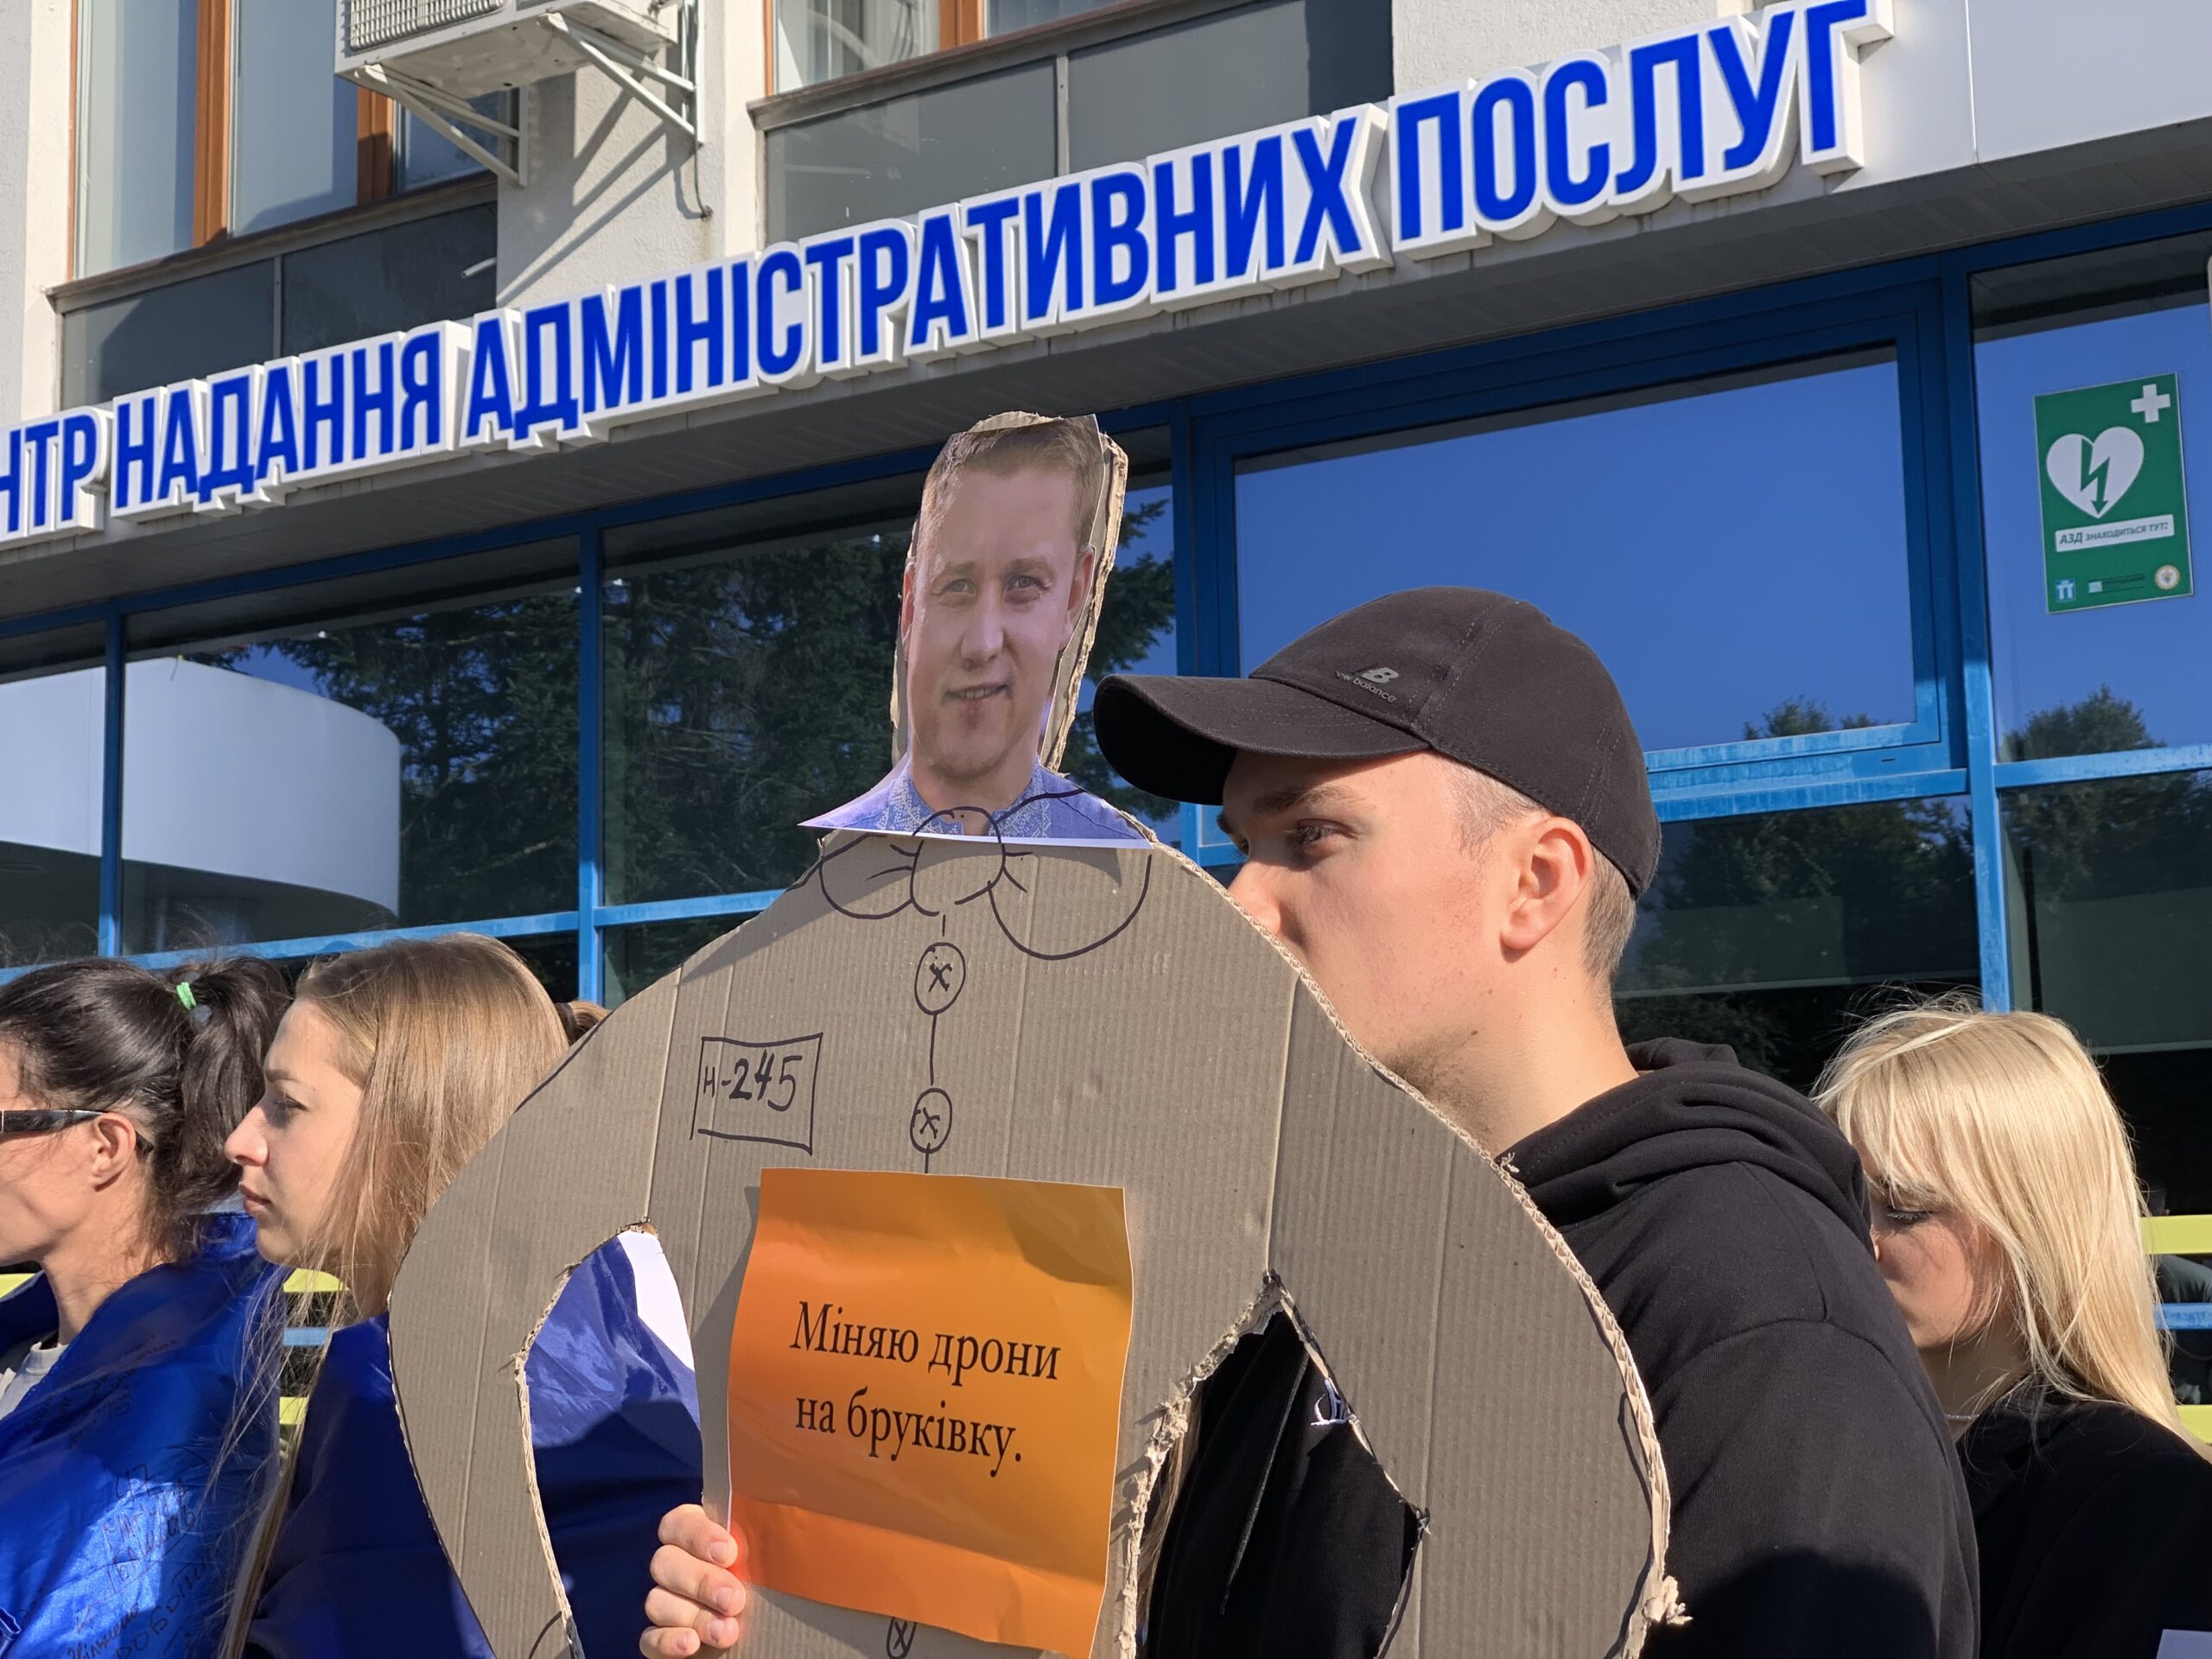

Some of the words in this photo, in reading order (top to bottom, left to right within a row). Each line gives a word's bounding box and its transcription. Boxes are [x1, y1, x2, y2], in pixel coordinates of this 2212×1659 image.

[116, 332, 441, 506] НАДАННЯ
[467, 118, 1362, 440] АДМІНІСТРАТИВНИХ
[1397, 0, 1867, 238] ПОСЛУГ
[2060, 531, 2082, 545] АЗД
[1353, 677, 1397, 702] balance
[790, 1301, 919, 1363] Міняю
[928, 1334, 1061, 1387] дрони
[796, 1397, 836, 1434] на
[847, 1386, 1021, 1478] бруківку.
